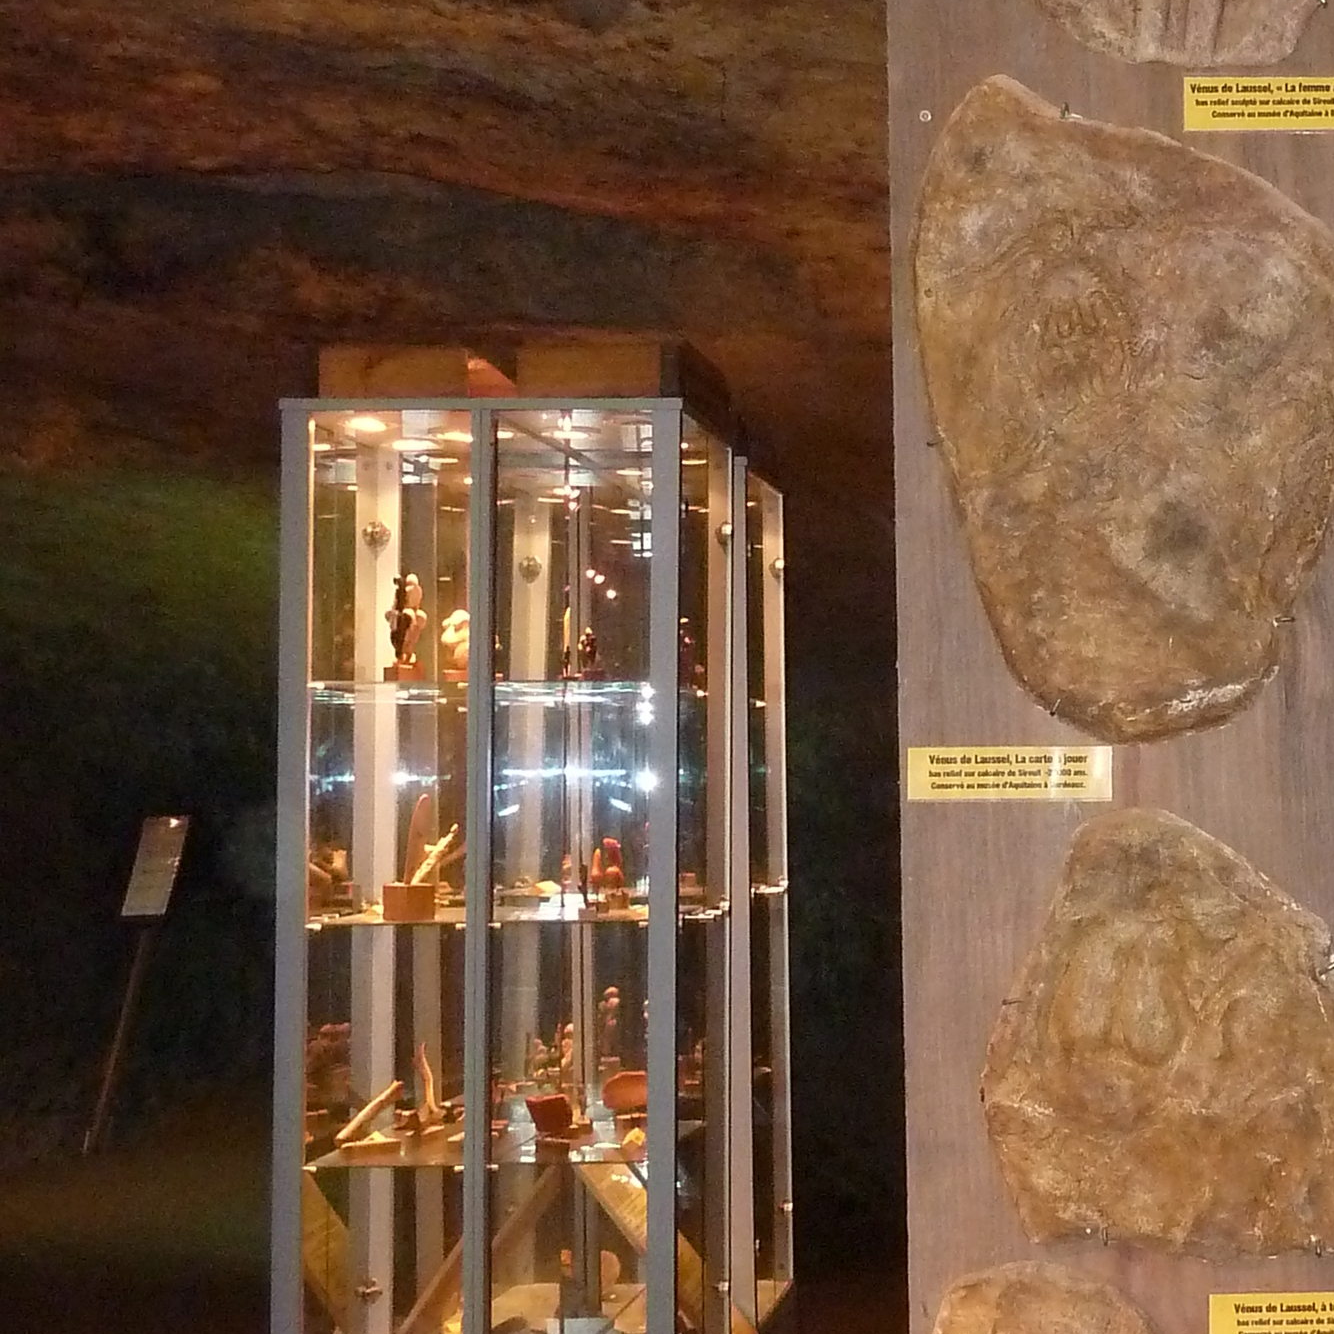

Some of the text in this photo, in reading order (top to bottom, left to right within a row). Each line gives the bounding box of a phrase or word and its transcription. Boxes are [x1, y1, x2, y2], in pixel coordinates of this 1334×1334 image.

[1190, 84, 1219, 94] Vénus
[1221, 83, 1233, 93] de
[1236, 83, 1273, 94] Laussel,
[1285, 83, 1296, 92] La
[1299, 82, 1330, 92] femme
[1210, 98, 1229, 106] relief
[1231, 98, 1257, 107] sculpté
[1212, 110, 1245, 118] Conservé
[1283, 110, 1322, 118] d'Aquitaine
[929, 754, 1087, 765] Vénus de Laussel, La carte jouer
[977, 769, 1005, 777] calcaire
[1002, 781, 1042, 790] d'Aquitaine
[1053, 780, 1086, 788] ordeaux.
[1234, 1304, 1263, 1313] Vénus
[1266, 1303, 1277, 1312] de
[1280, 1302, 1318, 1313] Laussel,
[1321, 1302, 1326, 1311] à
[1251, 1318, 1270, 1326] relief
